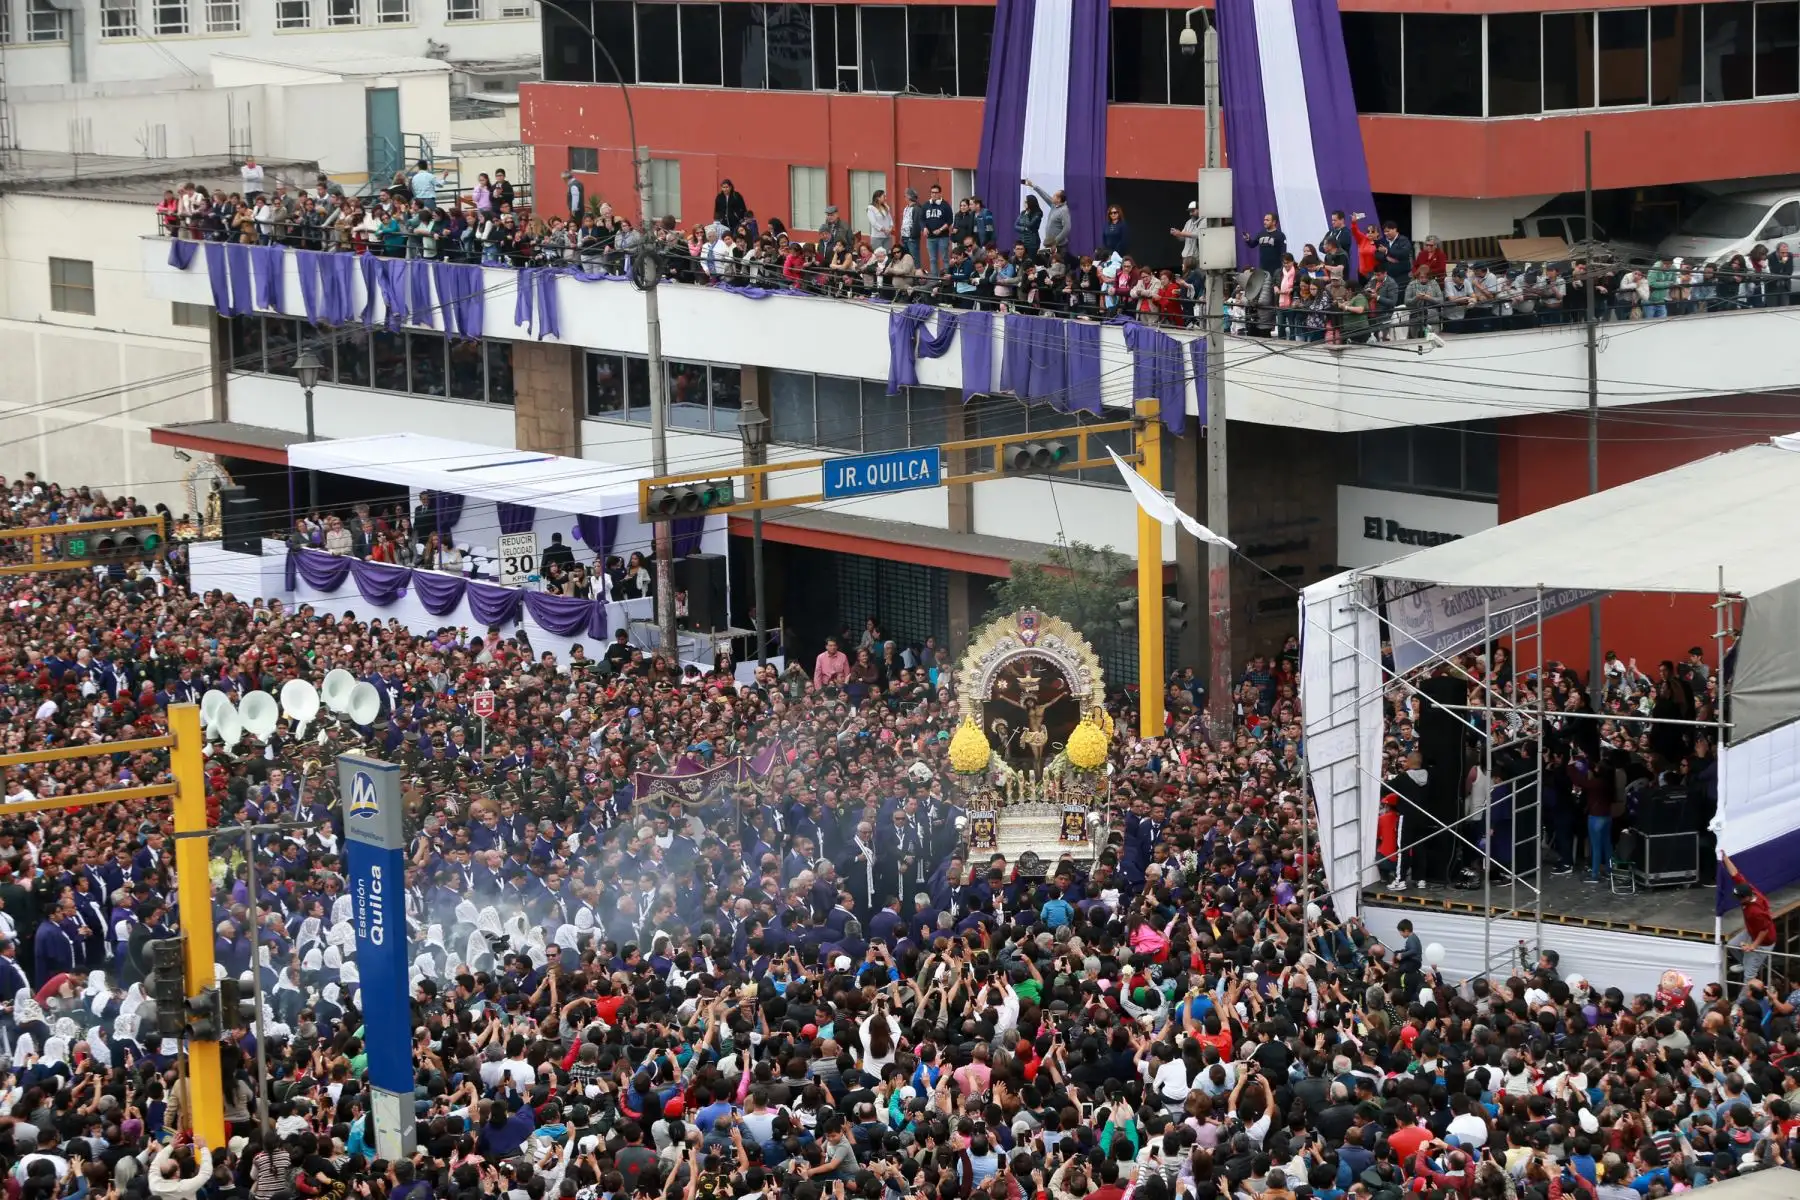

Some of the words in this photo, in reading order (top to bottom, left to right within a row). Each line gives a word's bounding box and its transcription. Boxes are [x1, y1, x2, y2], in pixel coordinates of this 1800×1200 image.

[925, 208, 942, 219] GAP
[834, 467, 862, 489] JR.
[866, 458, 930, 485] QUILCA
[1363, 516, 1383, 541] El
[501, 535, 533, 546] REDUCIR
[502, 546, 533, 556] VELOCIDAD
[505, 555, 534, 575] 30
[357, 878, 367, 938] Estación
[369, 865, 384, 946] Quilca
